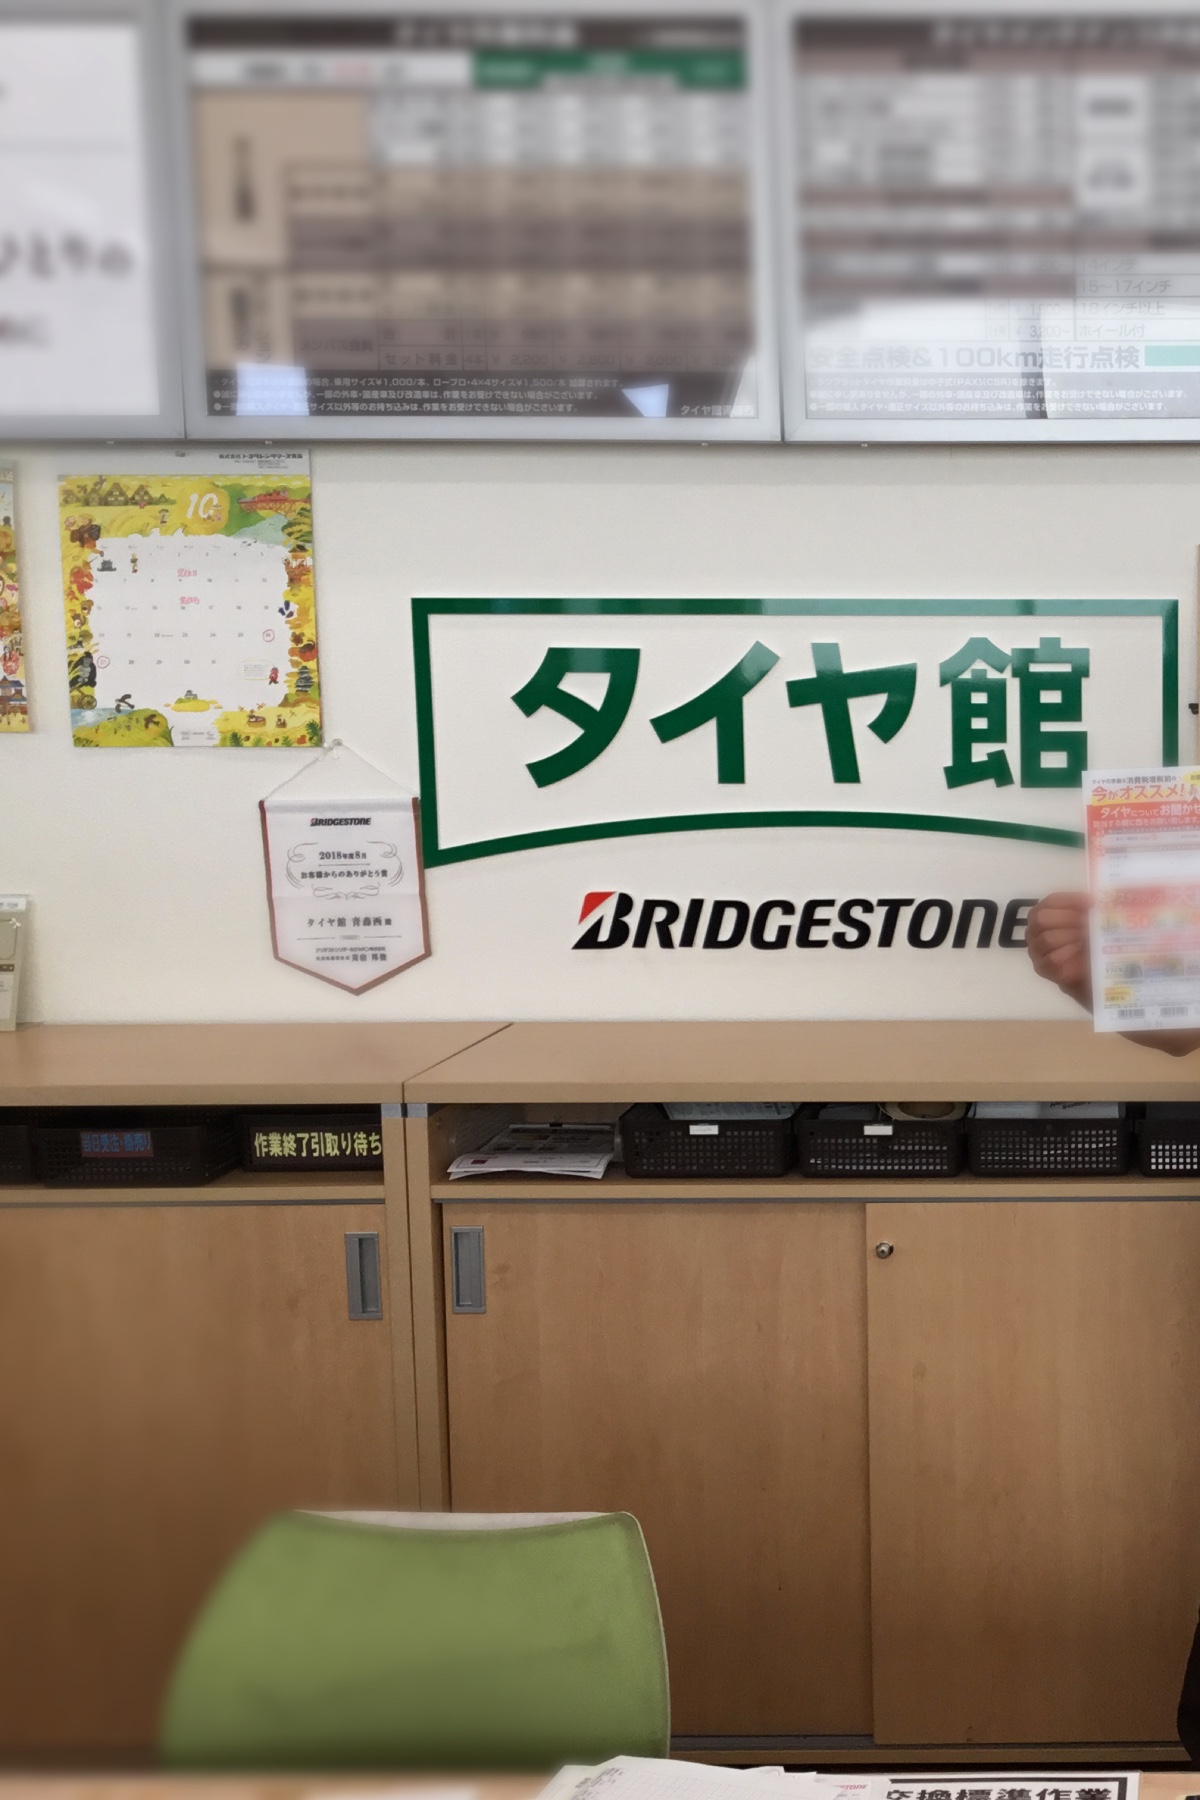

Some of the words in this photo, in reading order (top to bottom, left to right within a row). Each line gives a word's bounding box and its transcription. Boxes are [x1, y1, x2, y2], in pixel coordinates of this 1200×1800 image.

[186, 493, 218, 519] 10
[511, 637, 1090, 789] タイヤ館
[310, 817, 371, 828] BRIDGESTONE
[307, 917, 347, 928] タイヤ館
[572, 890, 1029, 950] BRIDGESTONE
[254, 1131, 381, 1158] 作業終了引取り待ち
